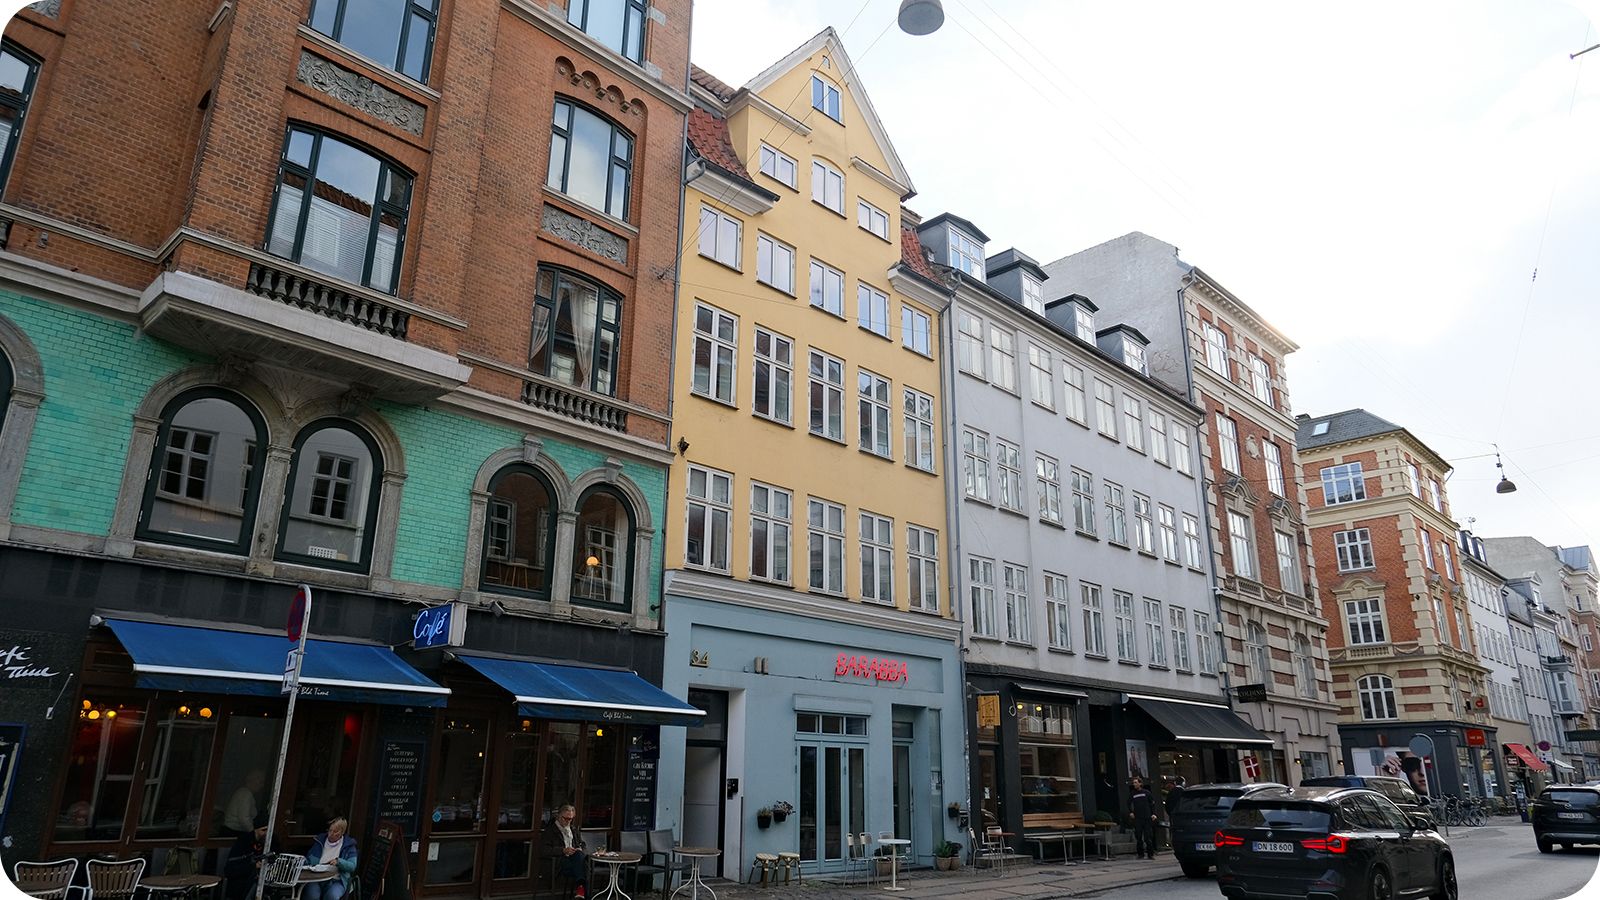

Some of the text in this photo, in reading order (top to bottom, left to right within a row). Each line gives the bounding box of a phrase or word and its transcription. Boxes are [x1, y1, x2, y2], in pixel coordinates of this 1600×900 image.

[414, 610, 448, 646] Café
[692, 650, 709, 666] 34
[4, 663, 60, 679] Time
[836, 653, 908, 682] BARABBA
[314, 687, 330, 696] Time
[1278, 843, 1292, 851] 600
